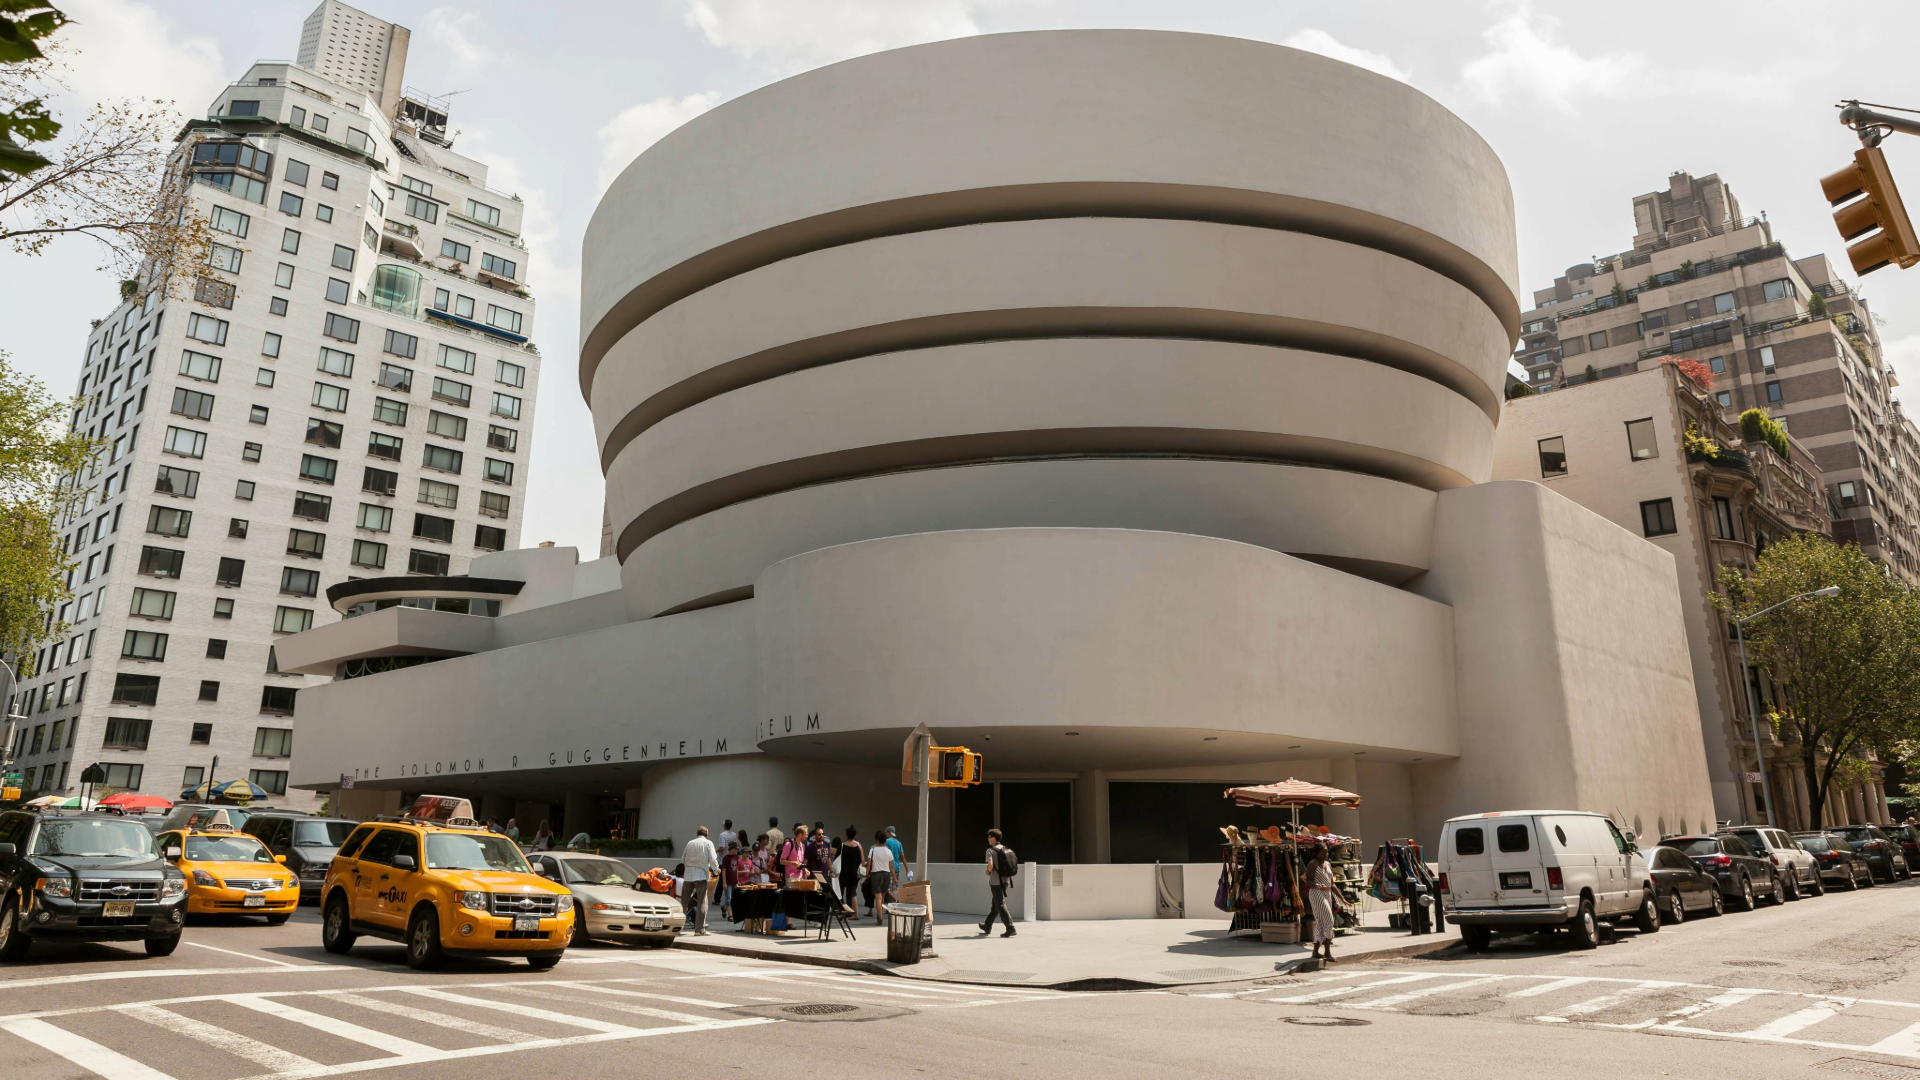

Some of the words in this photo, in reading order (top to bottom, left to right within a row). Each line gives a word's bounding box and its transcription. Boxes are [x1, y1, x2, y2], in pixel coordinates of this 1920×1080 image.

[354, 766, 381, 780] THE
[400, 758, 485, 778] SOLOMON
[512, 755, 519, 769] R
[548, 737, 729, 766] GUGGENHEIM
[388, 886, 408, 904] TAXI
